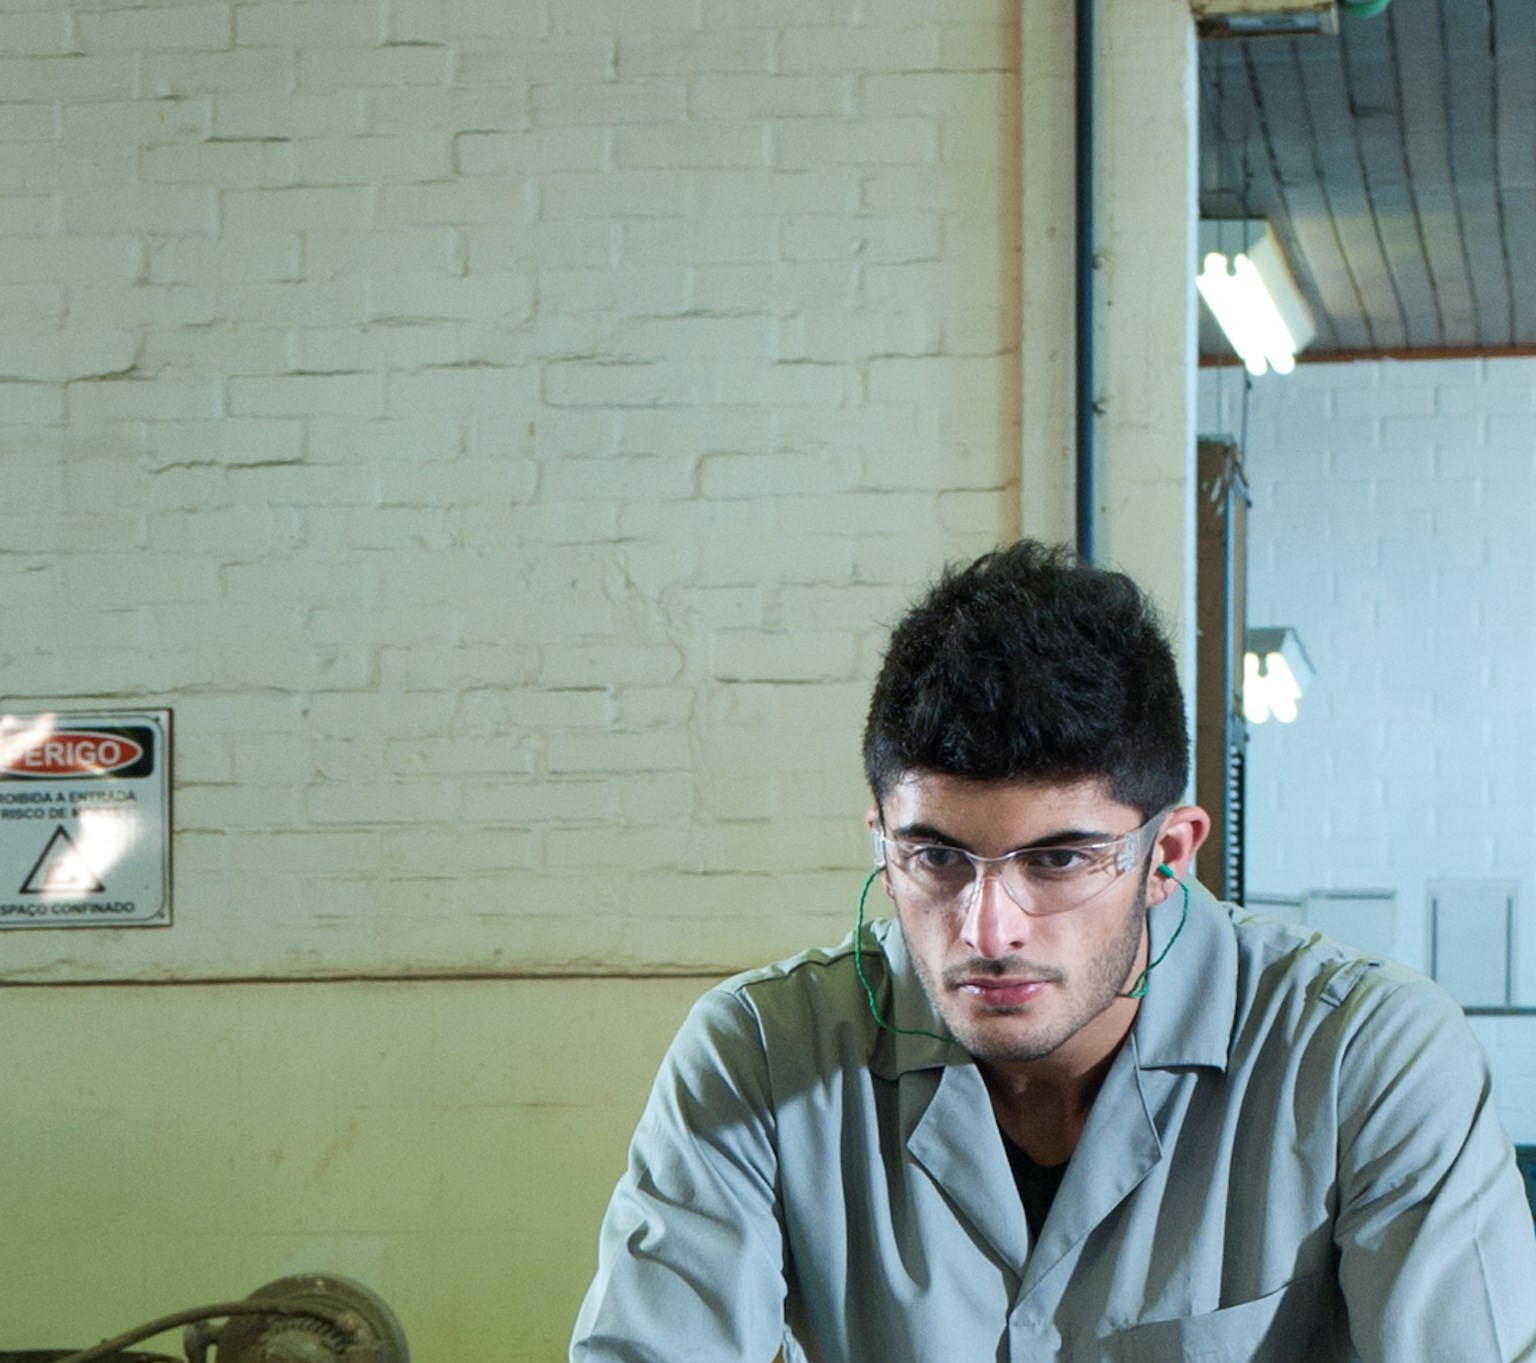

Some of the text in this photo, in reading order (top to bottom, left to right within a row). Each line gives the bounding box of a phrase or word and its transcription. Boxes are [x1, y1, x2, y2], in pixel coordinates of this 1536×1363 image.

[8, 740, 122, 767] ERIGO
[56, 791, 66, 803] A
[0, 807, 45, 819] RISCO
[48, 807, 67, 819] DE
[51, 902, 135, 914] CONFINADO
